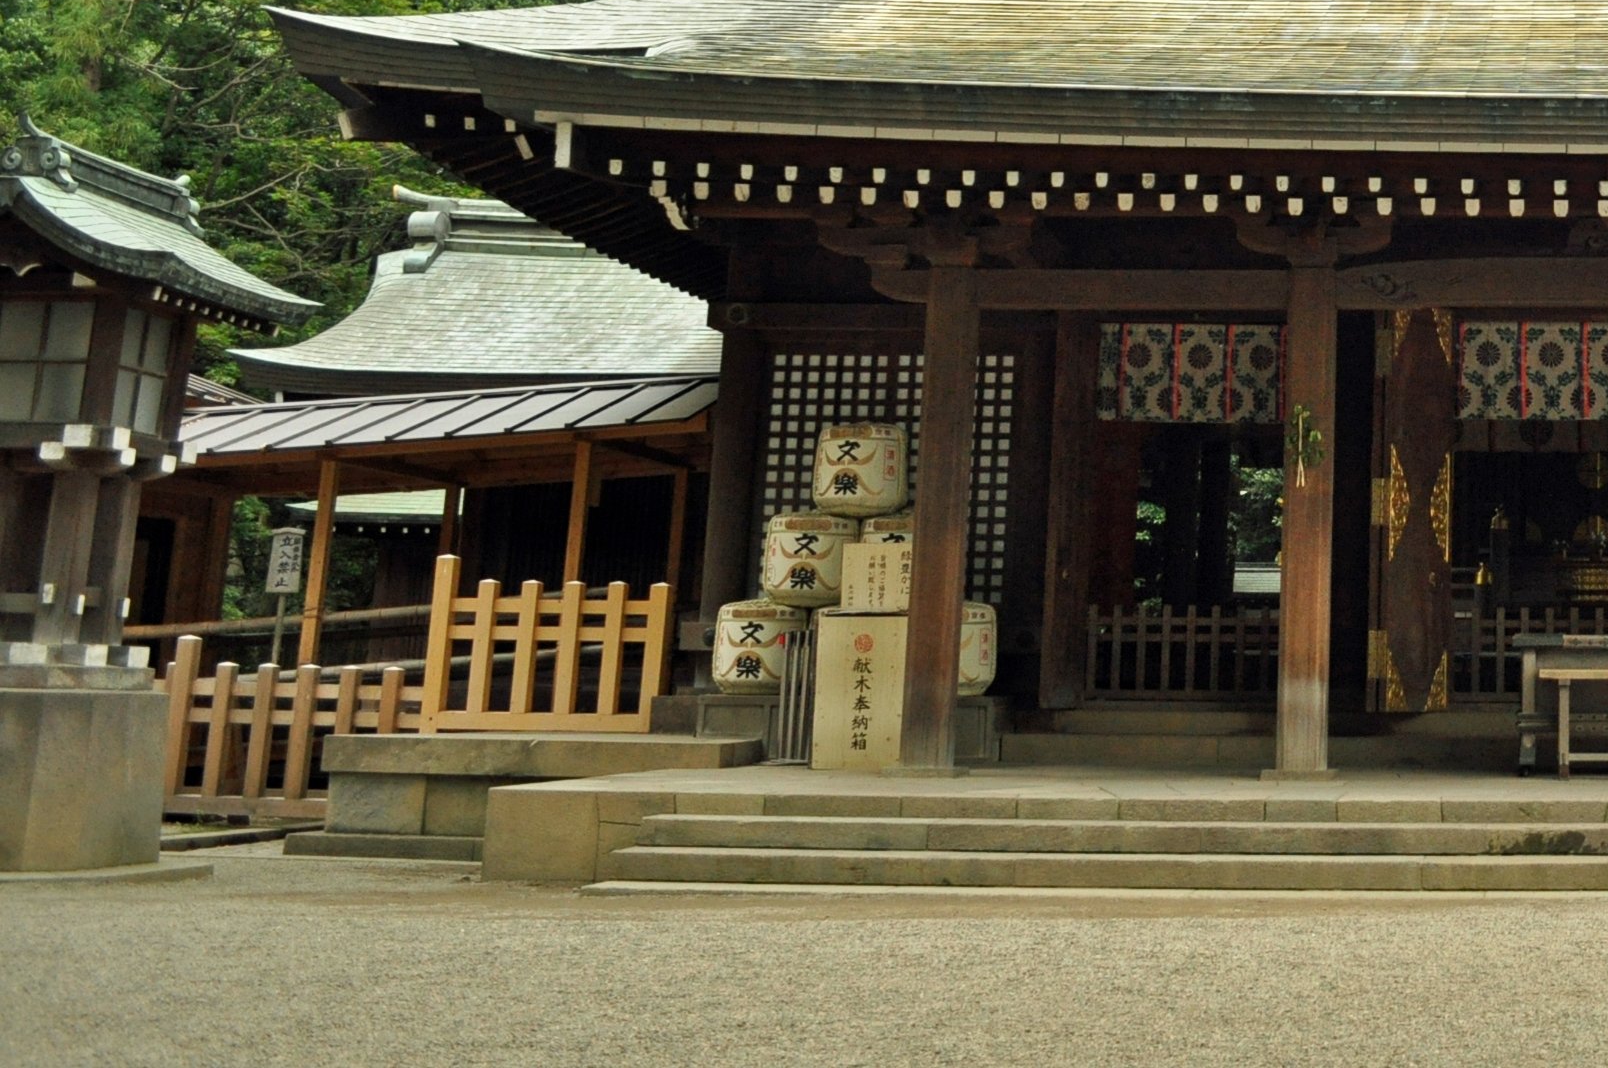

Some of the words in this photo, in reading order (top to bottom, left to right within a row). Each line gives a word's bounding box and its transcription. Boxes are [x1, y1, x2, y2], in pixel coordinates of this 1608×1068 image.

[275, 535, 294, 588] 立入禁止
[850, 657, 873, 751] 献木奉納箱
